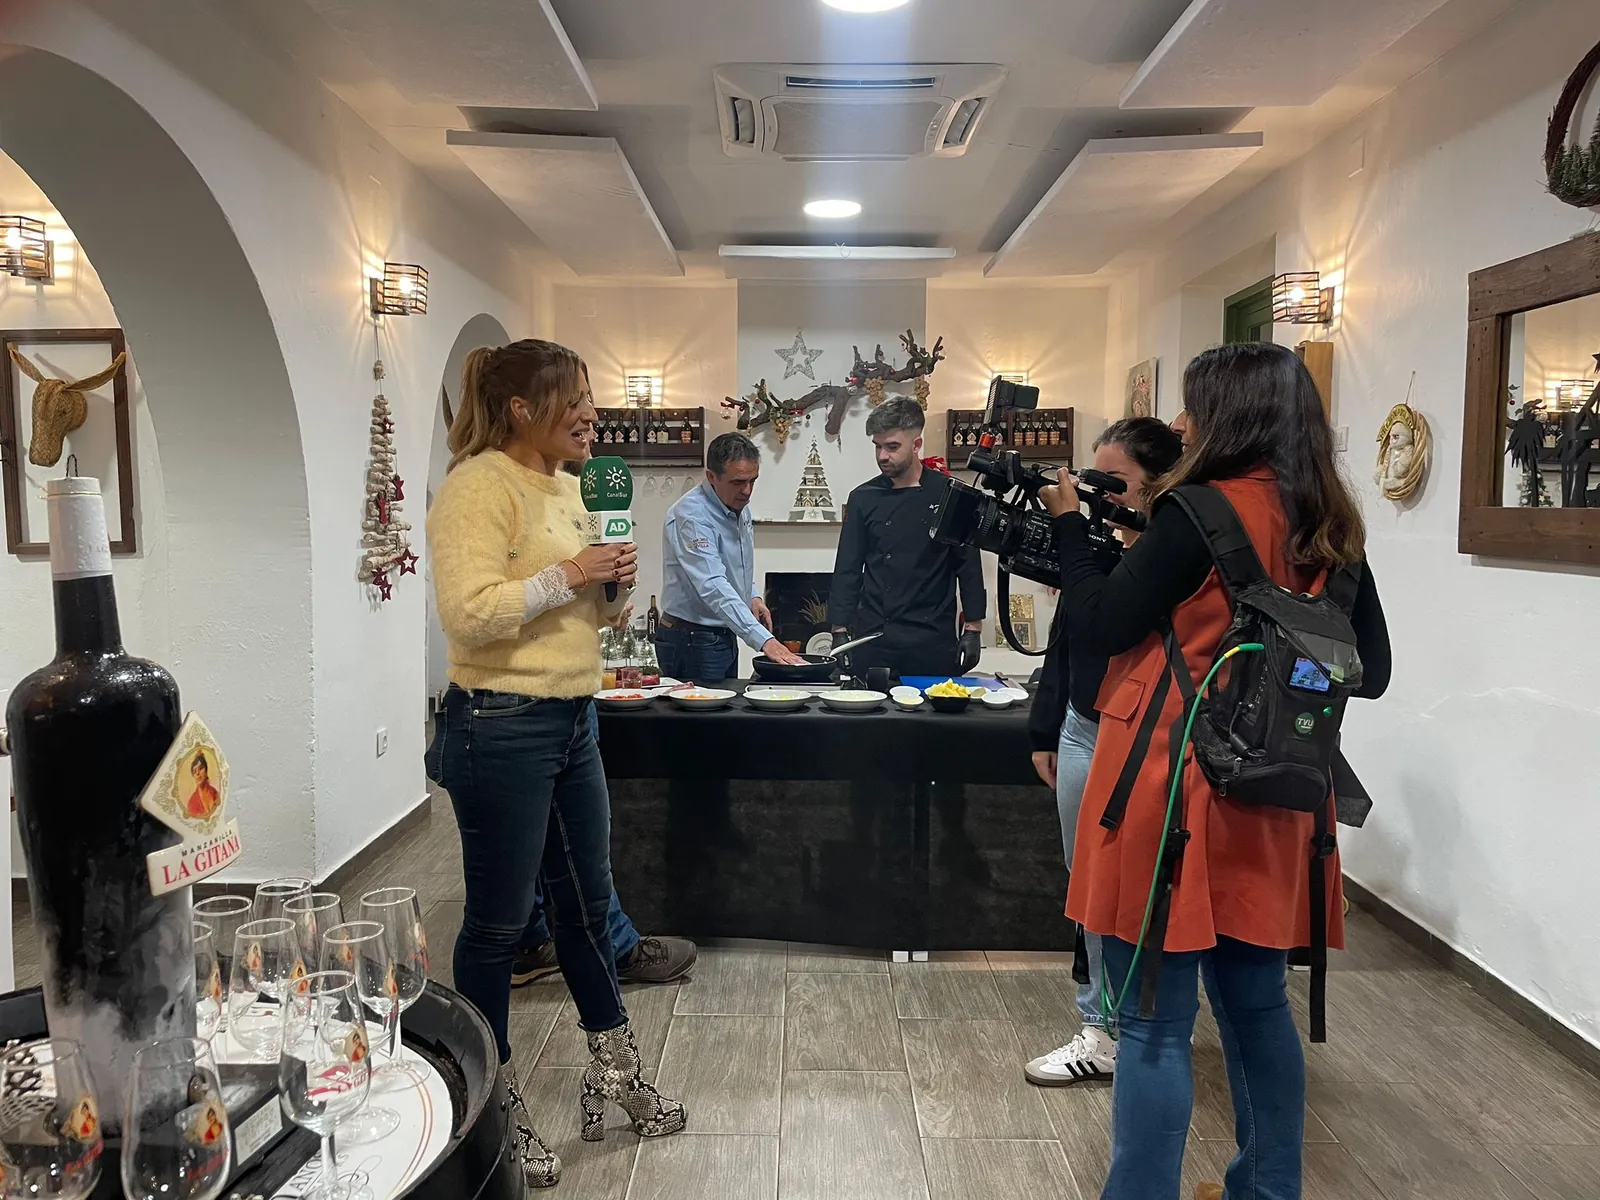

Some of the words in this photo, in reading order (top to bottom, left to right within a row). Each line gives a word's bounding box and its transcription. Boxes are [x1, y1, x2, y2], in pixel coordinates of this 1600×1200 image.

[609, 522, 627, 532] AD
[182, 830, 232, 856] MANZANILLA
[161, 859, 191, 885] LA
[194, 835, 239, 872] GITANA
